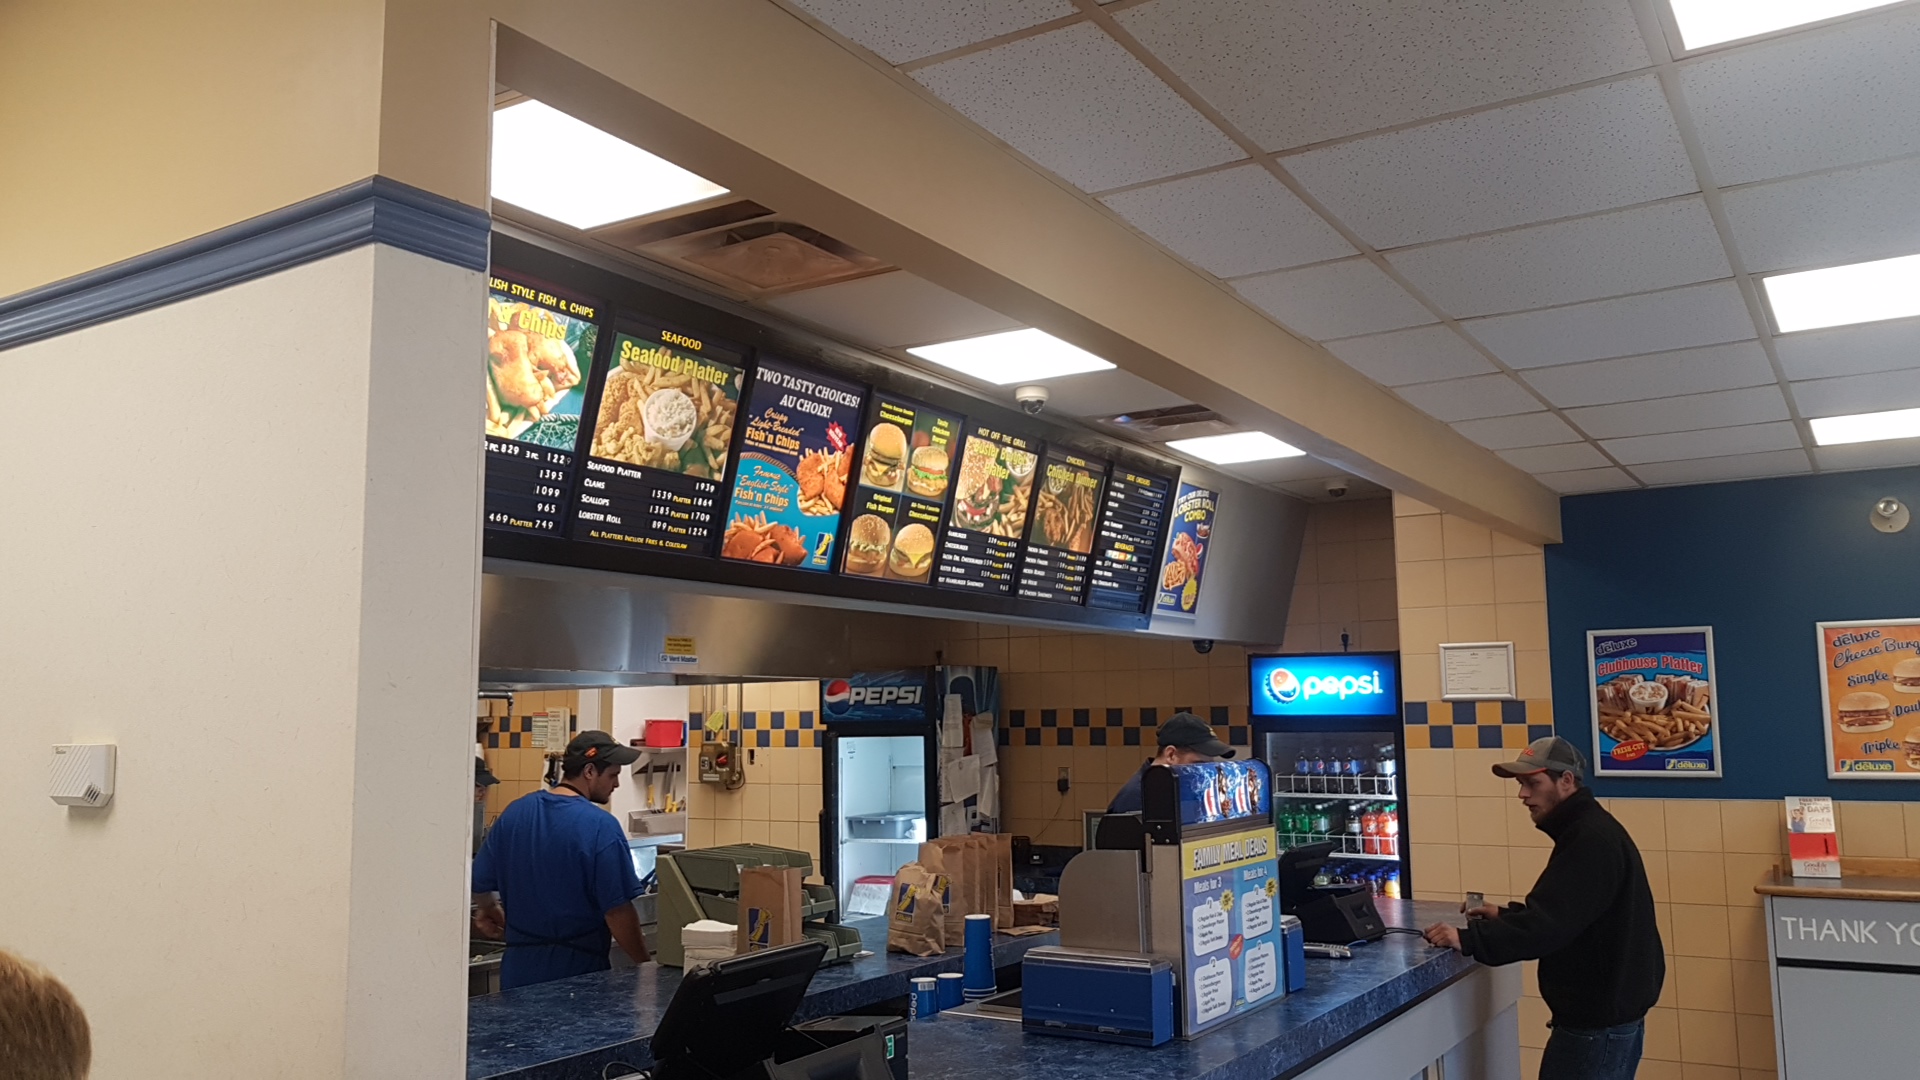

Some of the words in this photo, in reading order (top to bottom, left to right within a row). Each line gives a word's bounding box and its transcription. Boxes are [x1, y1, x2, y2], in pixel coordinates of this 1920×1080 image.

[489, 277, 508, 291] LISH
[511, 284, 535, 300] STYLE
[538, 292, 557, 307] FISH
[559, 300, 567, 310] &
[570, 303, 594, 318] CHIPS
[661, 330, 702, 350] SEAFOOD
[621, 340, 680, 373] Seafood
[682, 358, 729, 386] Platter
[756, 366, 782, 385] TWO
[782, 375, 815, 395] TASTY
[815, 385, 860, 408] CHOICES!
[764, 407, 788, 423] Crispy
[780, 394, 796, 408] AU
[796, 399, 833, 419] CHOIX!
[880, 410, 913, 426] Cheeseburger
[745, 426, 774, 444] Fish'n
[776, 434, 800, 450] Chips
[932, 426, 950, 436] Chicken
[977, 427, 989, 437] HOT
[991, 431, 1001, 440] OFF
[1002, 434, 1012, 444] THE
[1013, 437, 1027, 448] GRILL
[932, 435, 947, 445] Burger
[501, 444, 519, 455] 829
[973, 442, 999, 459] Buster
[1066, 455, 1086, 467] CHICKEN
[539, 469, 563, 481] 1395
[1047, 464, 1075, 482] Chicken
[1075, 472, 1097, 489] Dinner
[536, 485, 560, 498] 1099
[695, 482, 715, 493] 1939
[651, 489, 672, 500] 1539
[693, 497, 713, 507] 1864
[764, 492, 789, 507] Chips
[537, 503, 556, 513] 965
[649, 505, 670, 516] 1385
[690, 512, 710, 522] 1709
[866, 501, 877, 510] Fish
[878, 504, 895, 514] Burger
[909, 510, 939, 522] Cheeseburger
[1174, 498, 1202, 518] LOBSTER
[1202, 498, 1214, 512] ROLL
[1184, 509, 1206, 522] COMBO
[489, 513, 508, 524] 469
[509, 518, 533, 528] PLATTER
[535, 520, 554, 530] 749
[652, 520, 668, 531] 899
[688, 527, 708, 537] 1224
[1597, 657, 1658, 676] Clubhouse
[1661, 655, 1703, 674] Platter
[1833, 645, 1882, 669] Cheese
[1302, 670, 1380, 700] pepsi
[1847, 670, 1889, 687] Single
[848, 686, 922, 705] PEPSI
[1862, 738, 1900, 754] Triple
[1193, 844, 1220, 871] FAMILY
[1223, 842, 1244, 864] MEAL
[1245, 835, 1267, 859] DEALS
[1243, 869, 1257, 881] Meals
[1264, 865, 1267, 876] 4
[1194, 880, 1210, 894] Meals
[1218, 876, 1222, 888] 3
[1781, 916, 1878, 944] THANK
